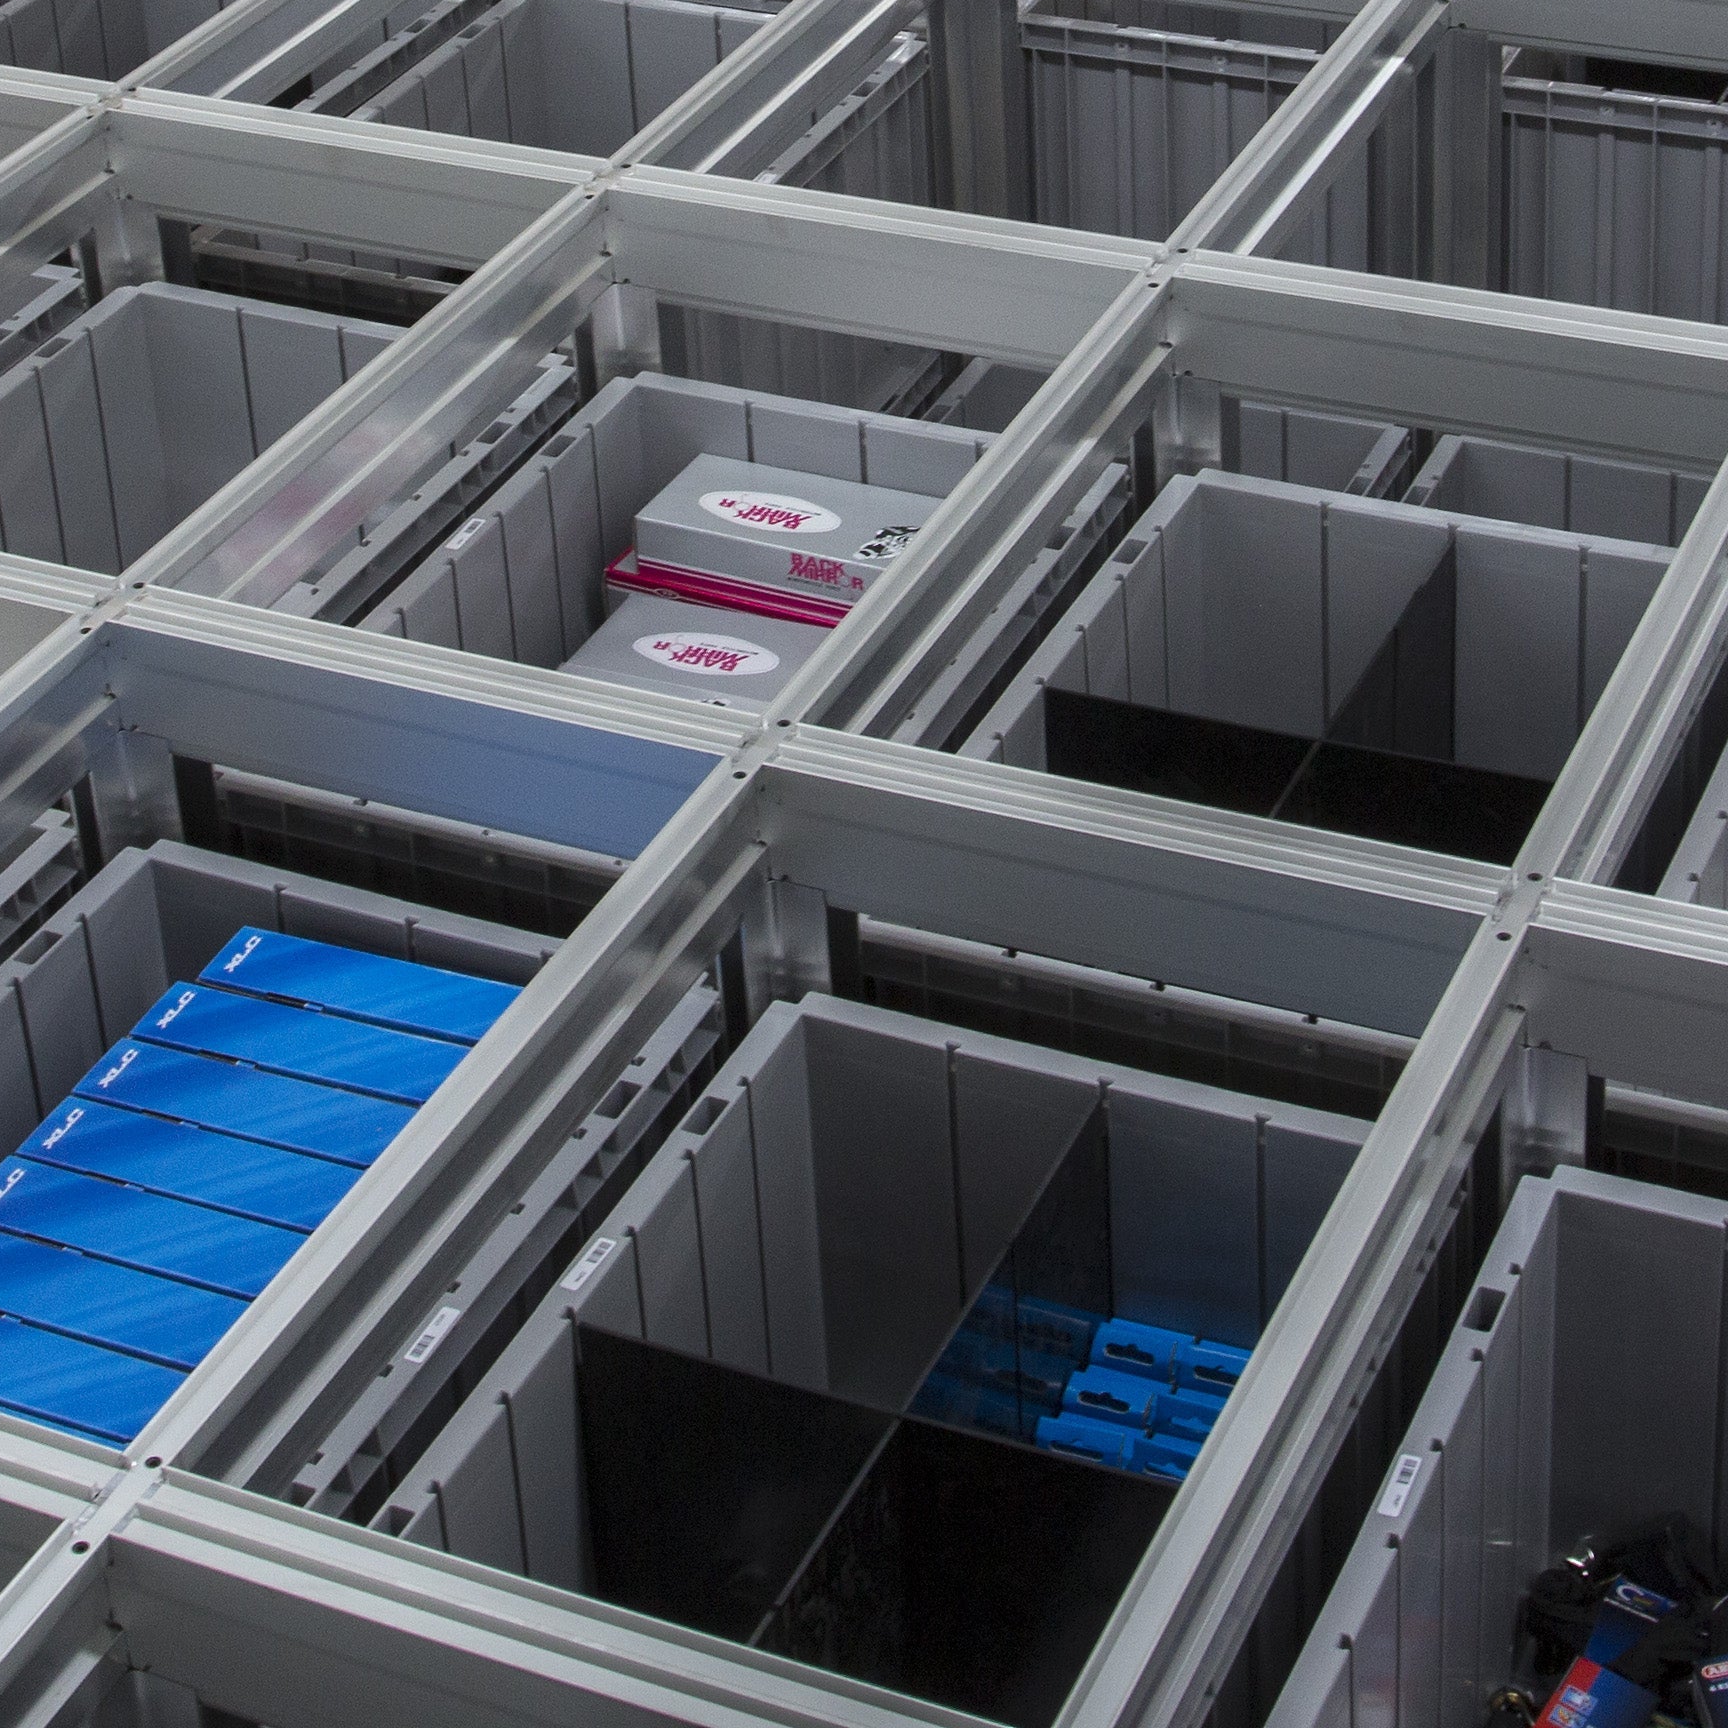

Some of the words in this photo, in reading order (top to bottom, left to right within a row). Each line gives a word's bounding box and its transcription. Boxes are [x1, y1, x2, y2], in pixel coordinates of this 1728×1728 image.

[789, 553, 847, 578] BACK
[223, 935, 263, 973] XLC
[156, 991, 197, 1029] XLC
[97, 1048, 139, 1088] XLC
[41, 1108, 86, 1150] XLC
